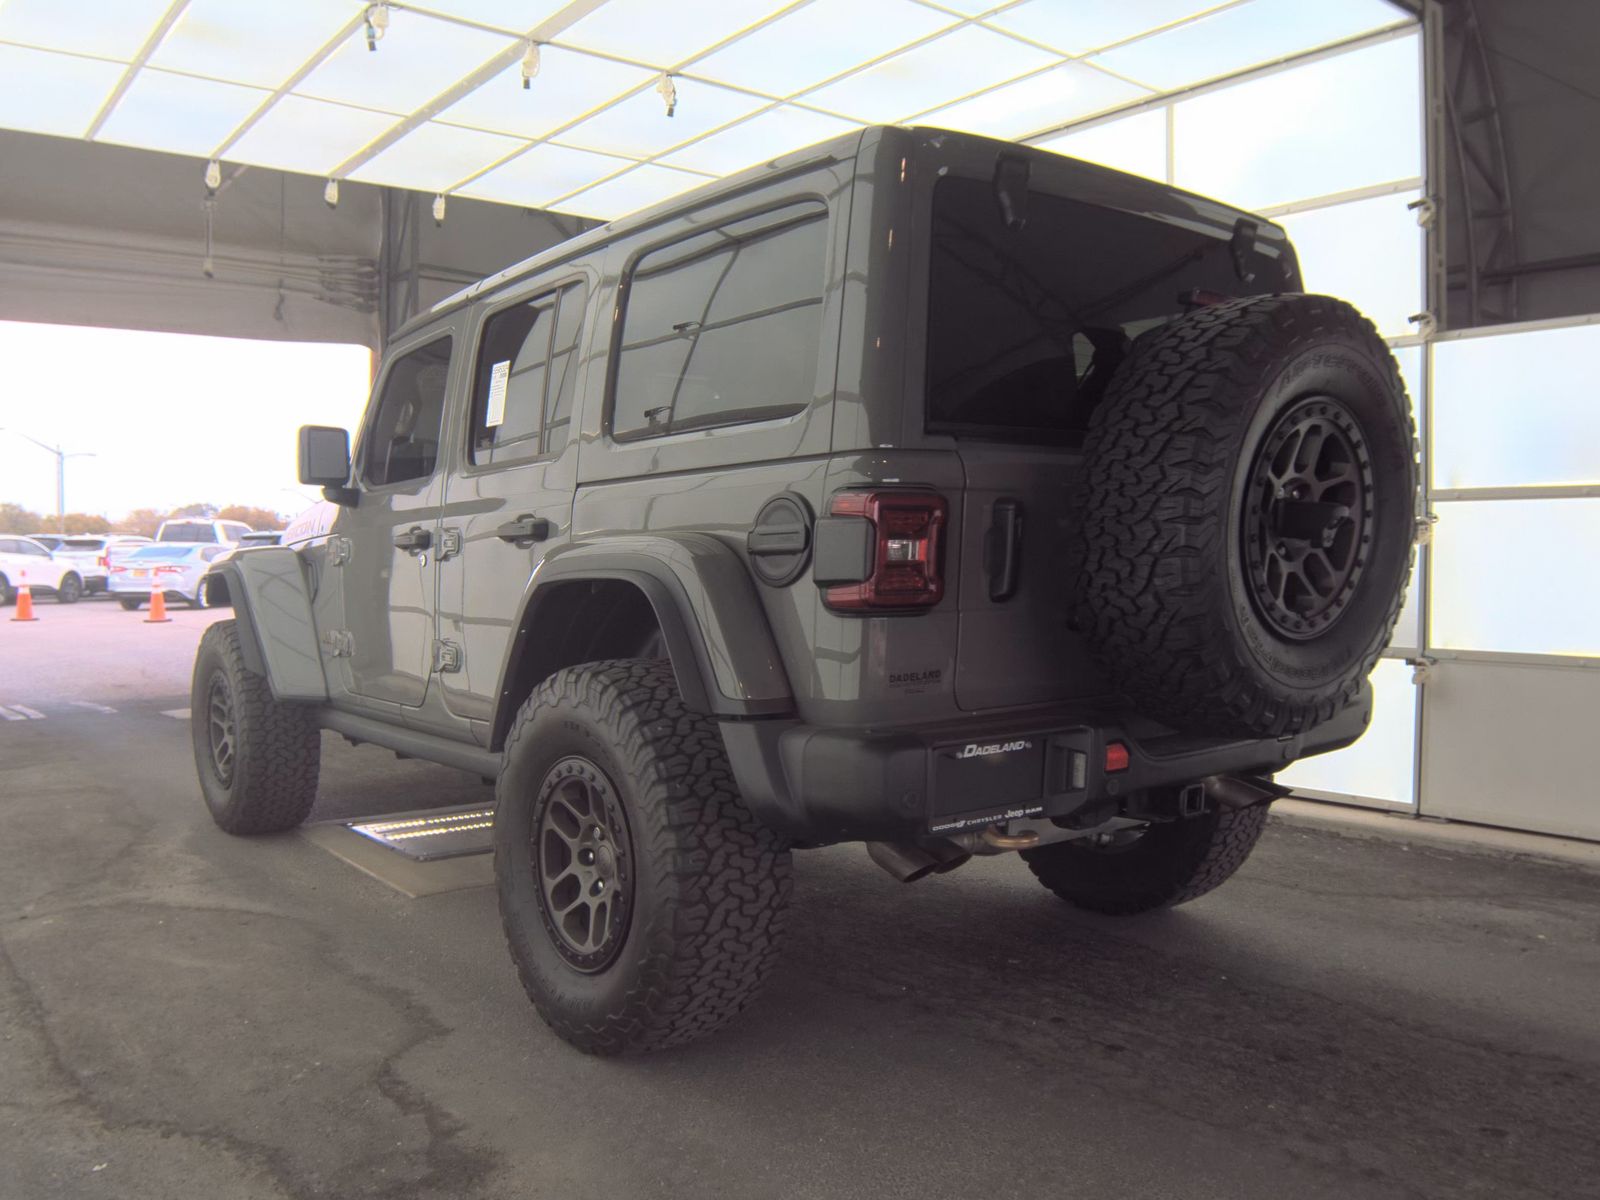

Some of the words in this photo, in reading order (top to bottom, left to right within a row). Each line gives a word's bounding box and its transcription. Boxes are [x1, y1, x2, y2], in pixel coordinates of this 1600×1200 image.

[889, 669, 942, 684] DADELAND
[963, 740, 1025, 758] DADELAND
[967, 815, 1002, 825] CHRYSLER
[1004, 809, 1024, 818] Jeep
